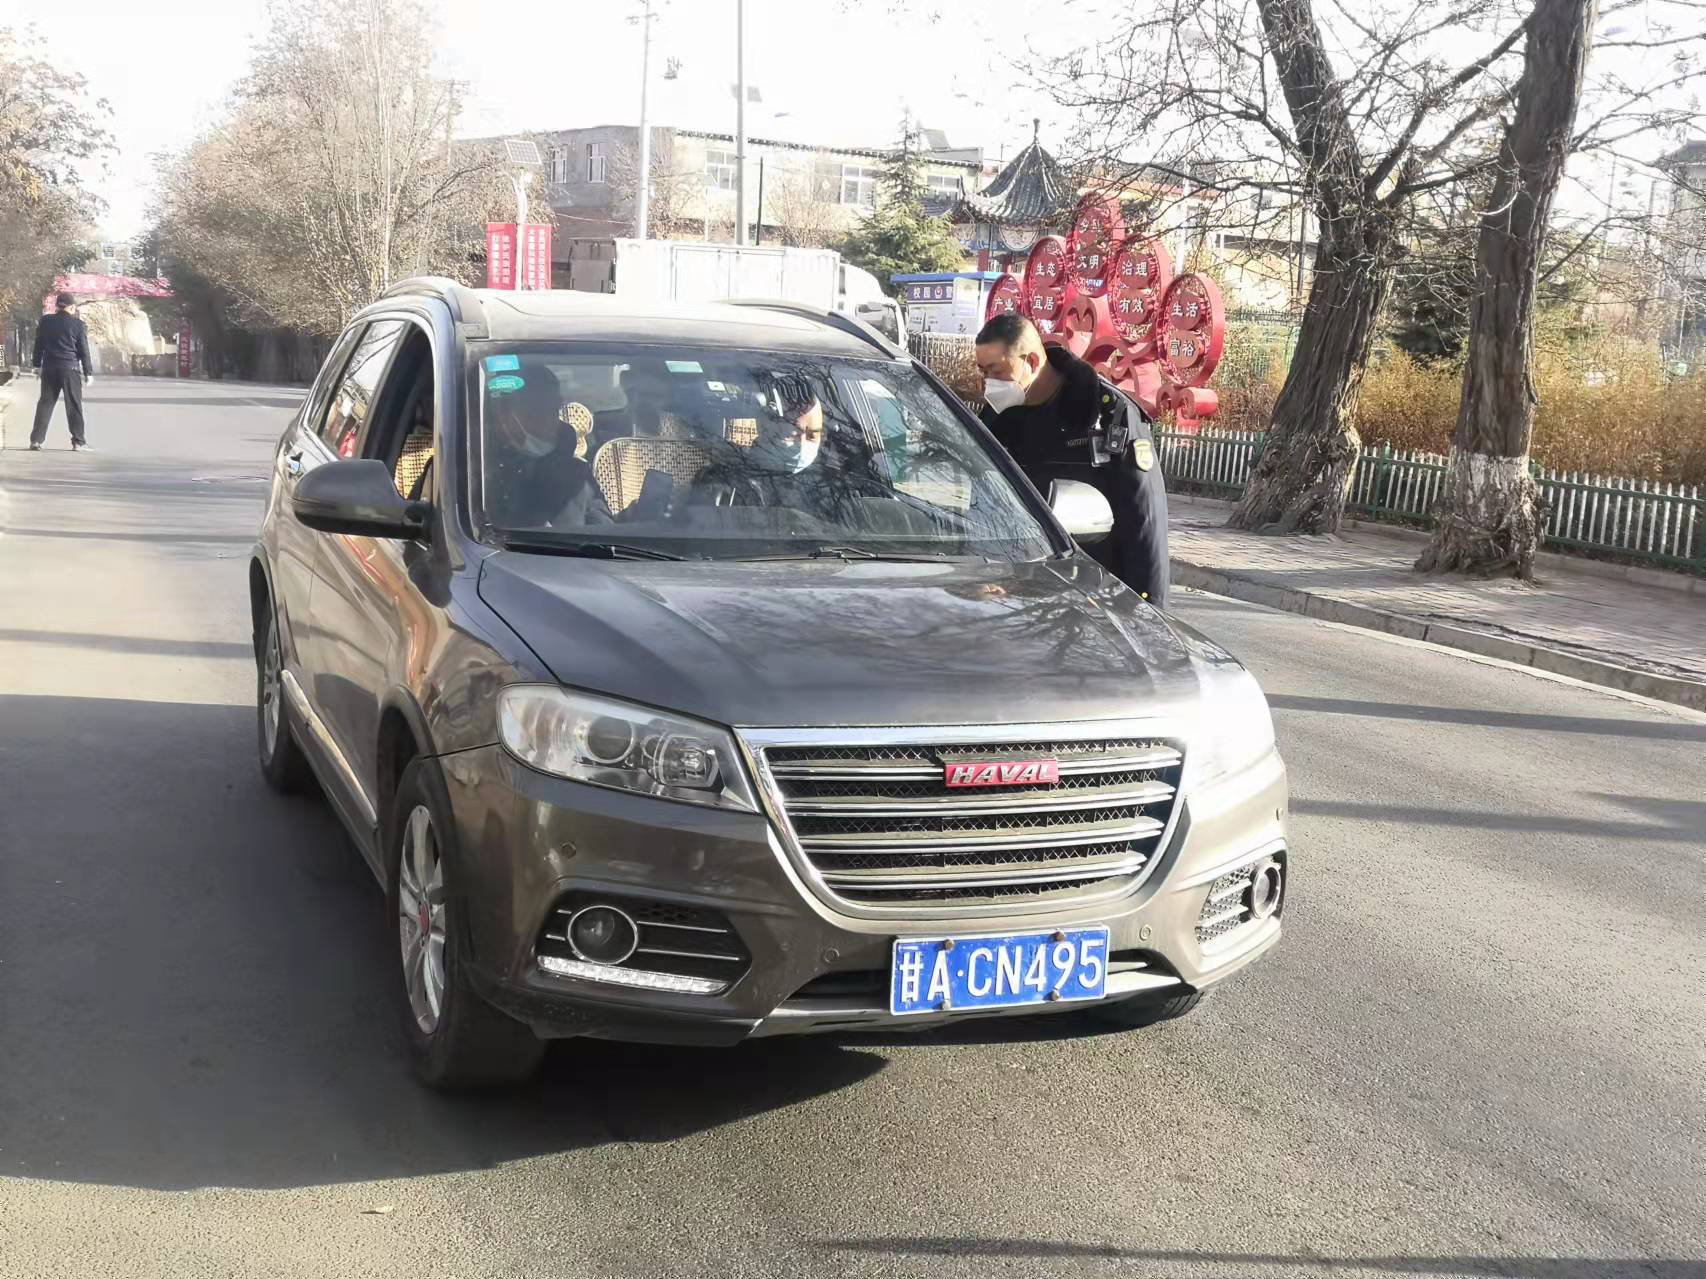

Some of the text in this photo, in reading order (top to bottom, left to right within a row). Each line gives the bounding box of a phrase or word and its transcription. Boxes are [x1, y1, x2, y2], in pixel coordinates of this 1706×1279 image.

[1035, 261, 1056, 277] 生态
[1077, 255, 1099, 269] 文明
[1122, 261, 1148, 277] 治理
[994, 296, 1014, 314] 产业
[1033, 294, 1054, 311] 宜居
[1119, 297, 1144, 314] 有效
[1171, 302, 1199, 317] 生活
[1170, 338, 1196, 357] 富裕
[950, 763, 1055, 784] HAVAL
[899, 939, 1104, 1004] 甘A·CN495
